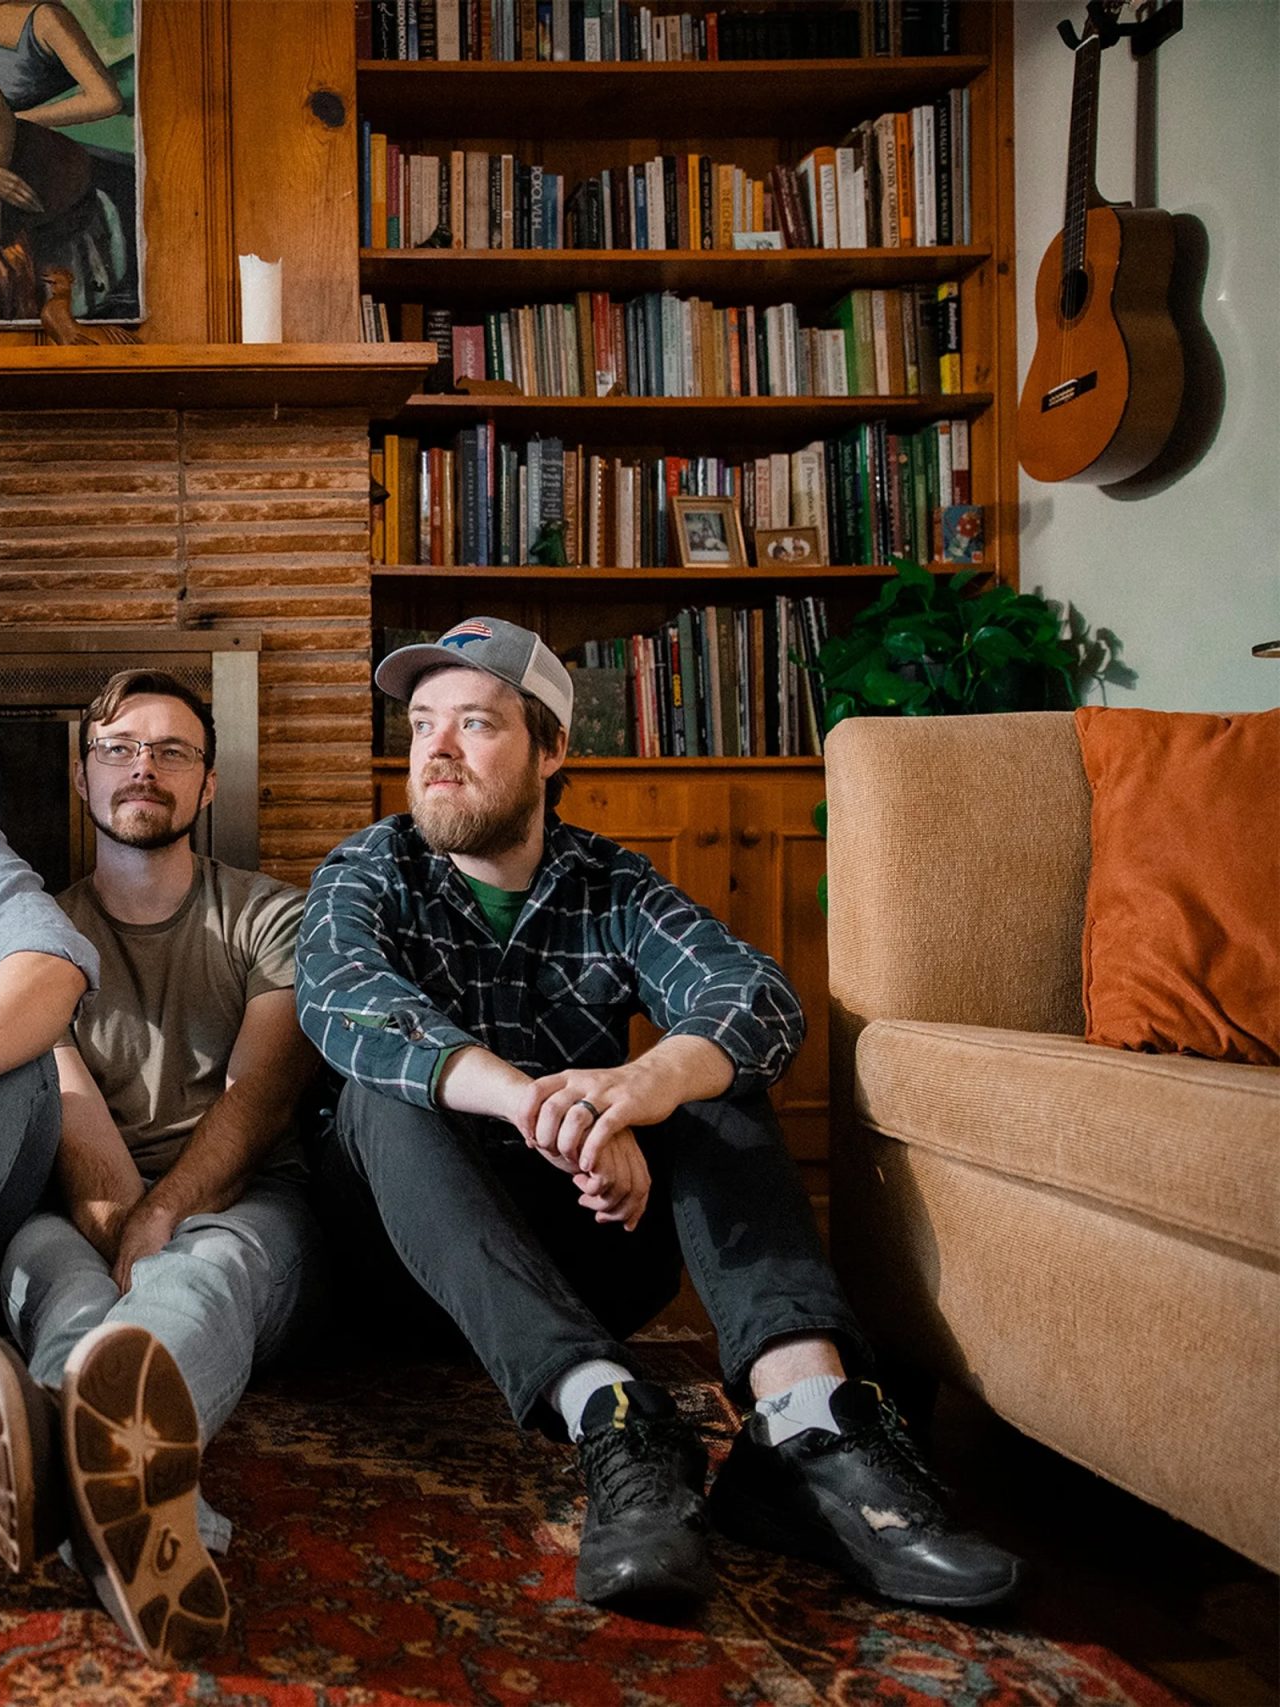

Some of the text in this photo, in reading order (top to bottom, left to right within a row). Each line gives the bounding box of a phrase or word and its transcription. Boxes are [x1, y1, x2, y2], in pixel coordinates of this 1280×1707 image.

[886, 141, 897, 187] COUNTRY
[531, 166, 543, 229] POPOL VUH
[823, 168, 834, 212] WOOD
